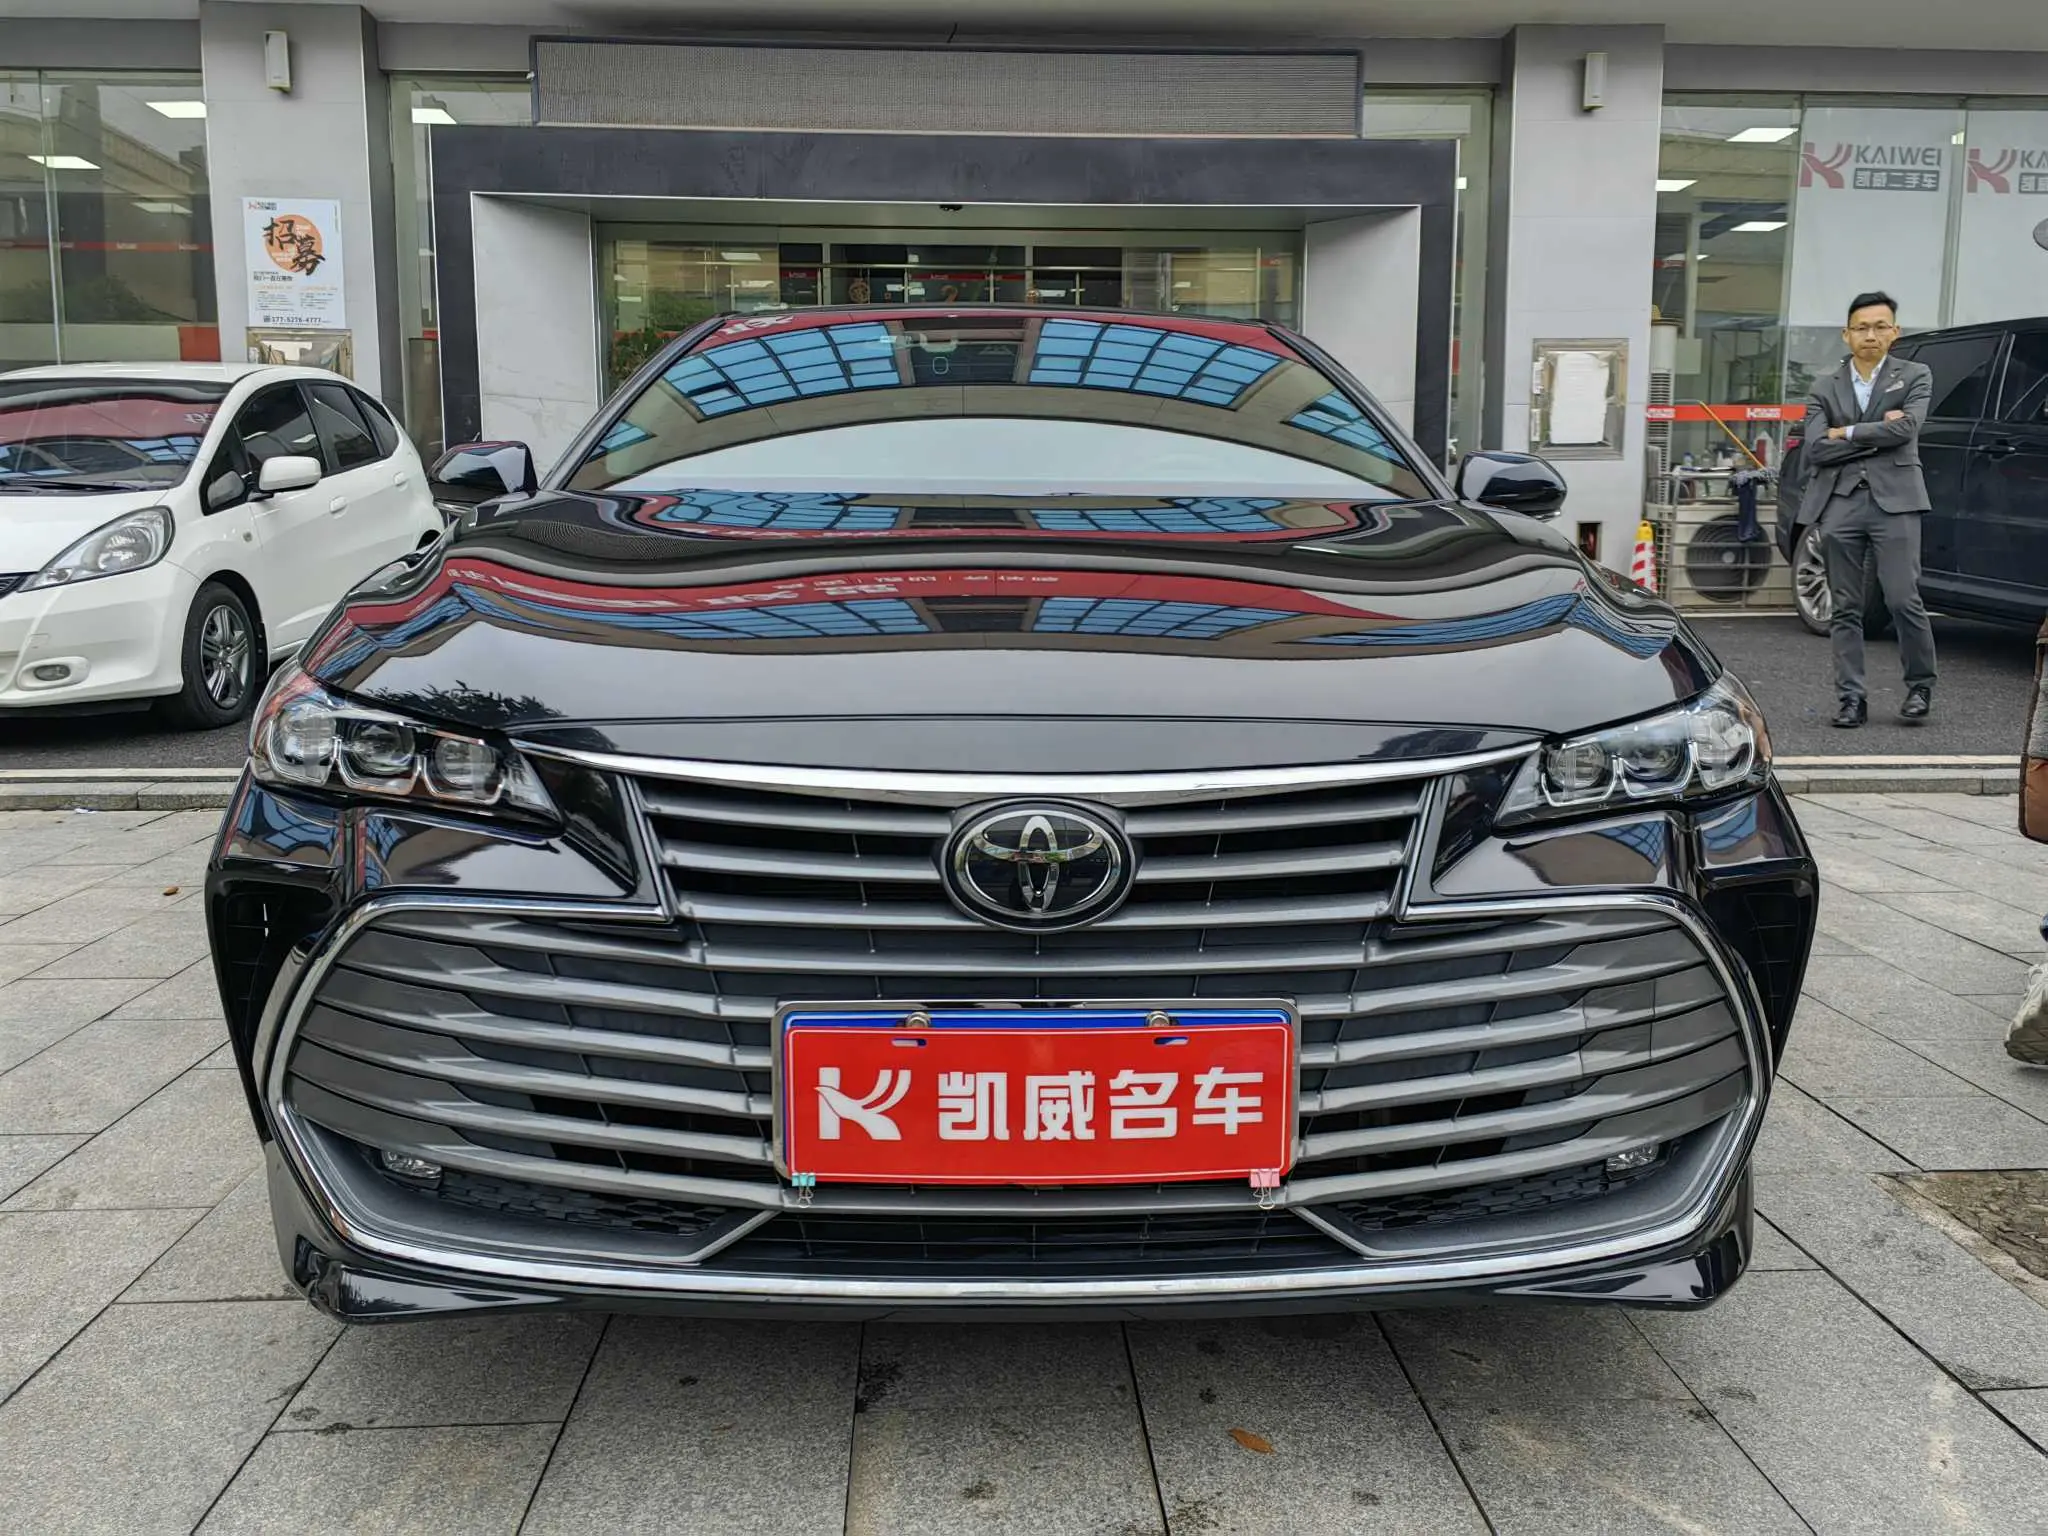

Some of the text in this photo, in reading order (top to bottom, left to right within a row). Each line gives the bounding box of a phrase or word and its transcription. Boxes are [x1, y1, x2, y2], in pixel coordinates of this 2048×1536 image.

[1855, 144, 1942, 167] KAIWEI
[1854, 170, 1938, 190] 凯威二手车
[262, 217, 325, 276] 招募
[937, 1067, 1264, 1141] 凯威名车
